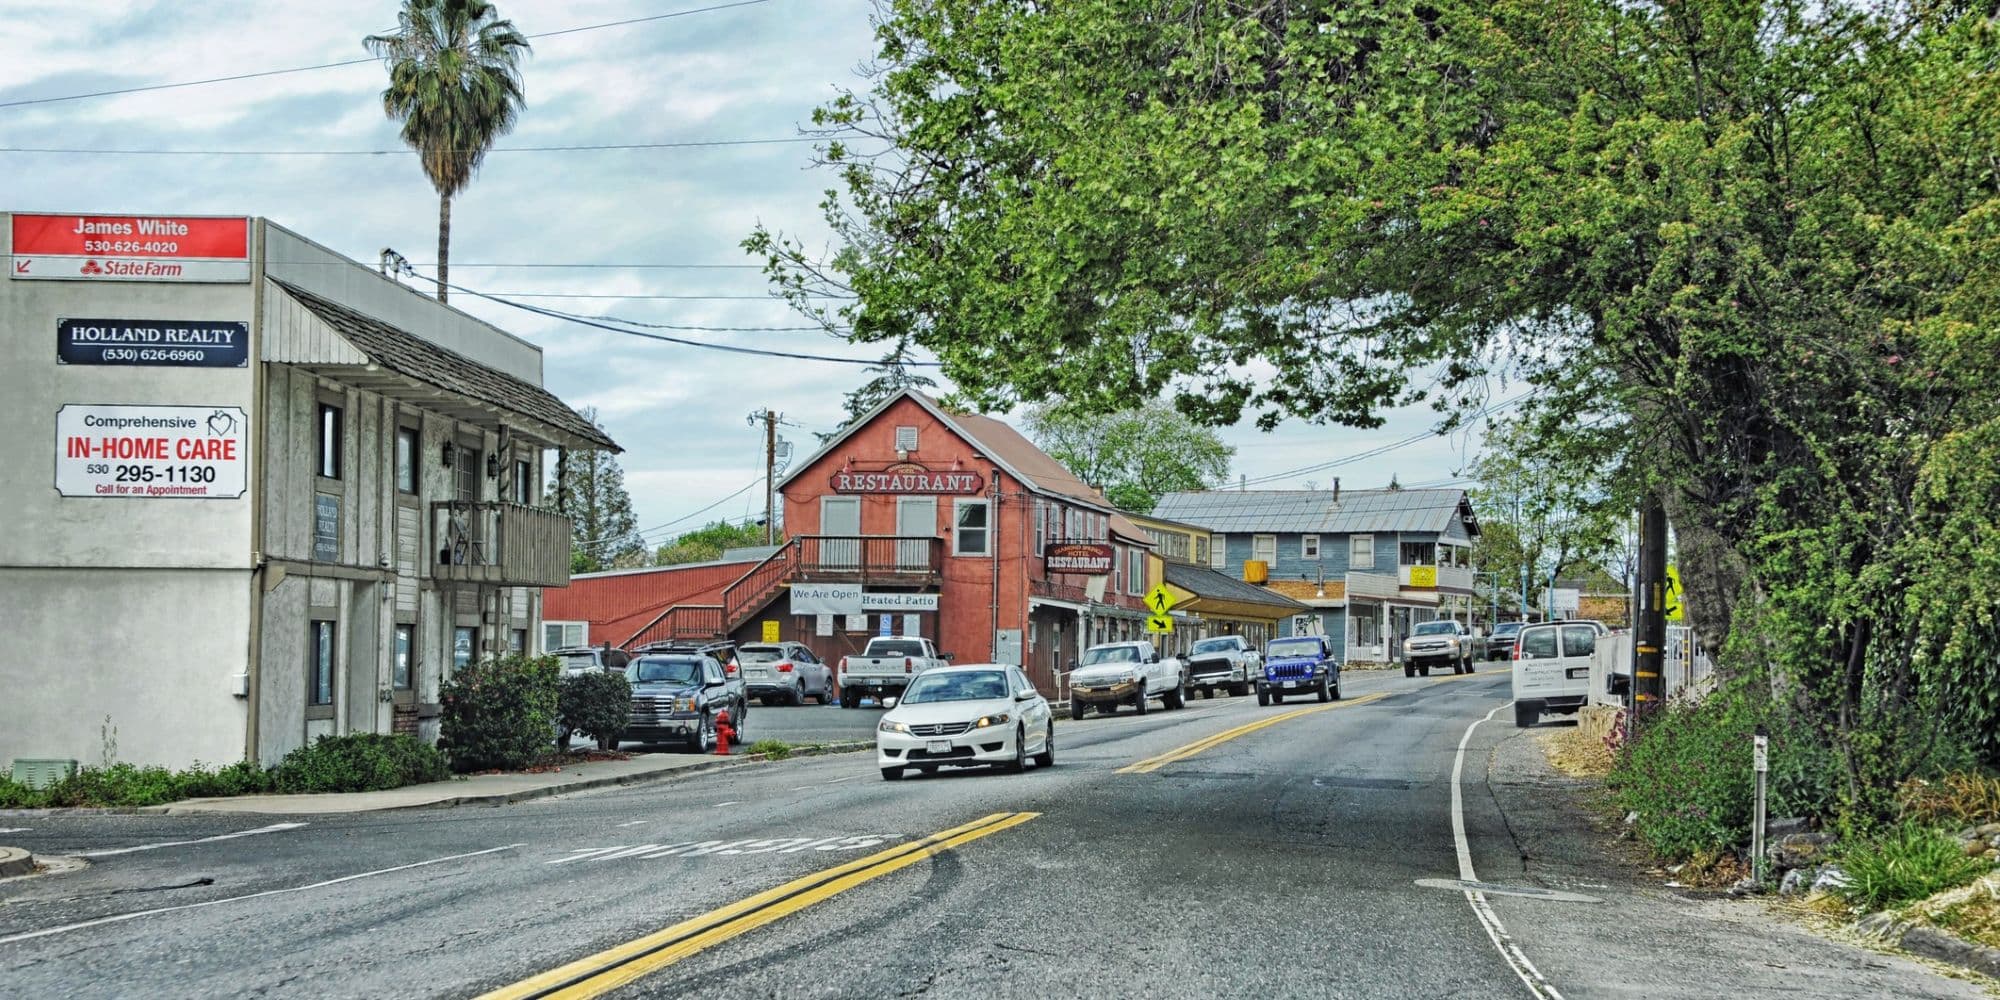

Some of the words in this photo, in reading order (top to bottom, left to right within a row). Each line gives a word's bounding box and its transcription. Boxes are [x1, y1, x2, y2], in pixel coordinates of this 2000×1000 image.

[73, 219, 132, 235] James
[137, 220, 188, 235] White
[85, 241, 178, 253] 530-626-4020
[72, 327, 160, 342] HOLLAND
[166, 328, 235, 344] REALTY
[102, 349, 138, 362] (530)
[140, 349, 204, 362] 626-6960
[84, 415, 196, 430] Comprehensive
[67, 436, 169, 459] IN-HOME
[176, 438, 236, 460] CARE
[87, 464, 109, 475] 530
[116, 465, 215, 483] 295-1130
[838, 474, 974, 491] RESTAURANT
[95, 484, 114, 495] Call
[116, 484, 130, 495] for
[132, 487, 144, 495] an
[146, 484, 207, 497] Appointment
[1048, 556, 1110, 568] RESTAURANT
[793, 590, 810, 598] We
[812, 590, 829, 598] Are
[832, 590, 859, 600] Open
[862, 595, 901, 605] Heated
[906, 595, 934, 605] Patio
